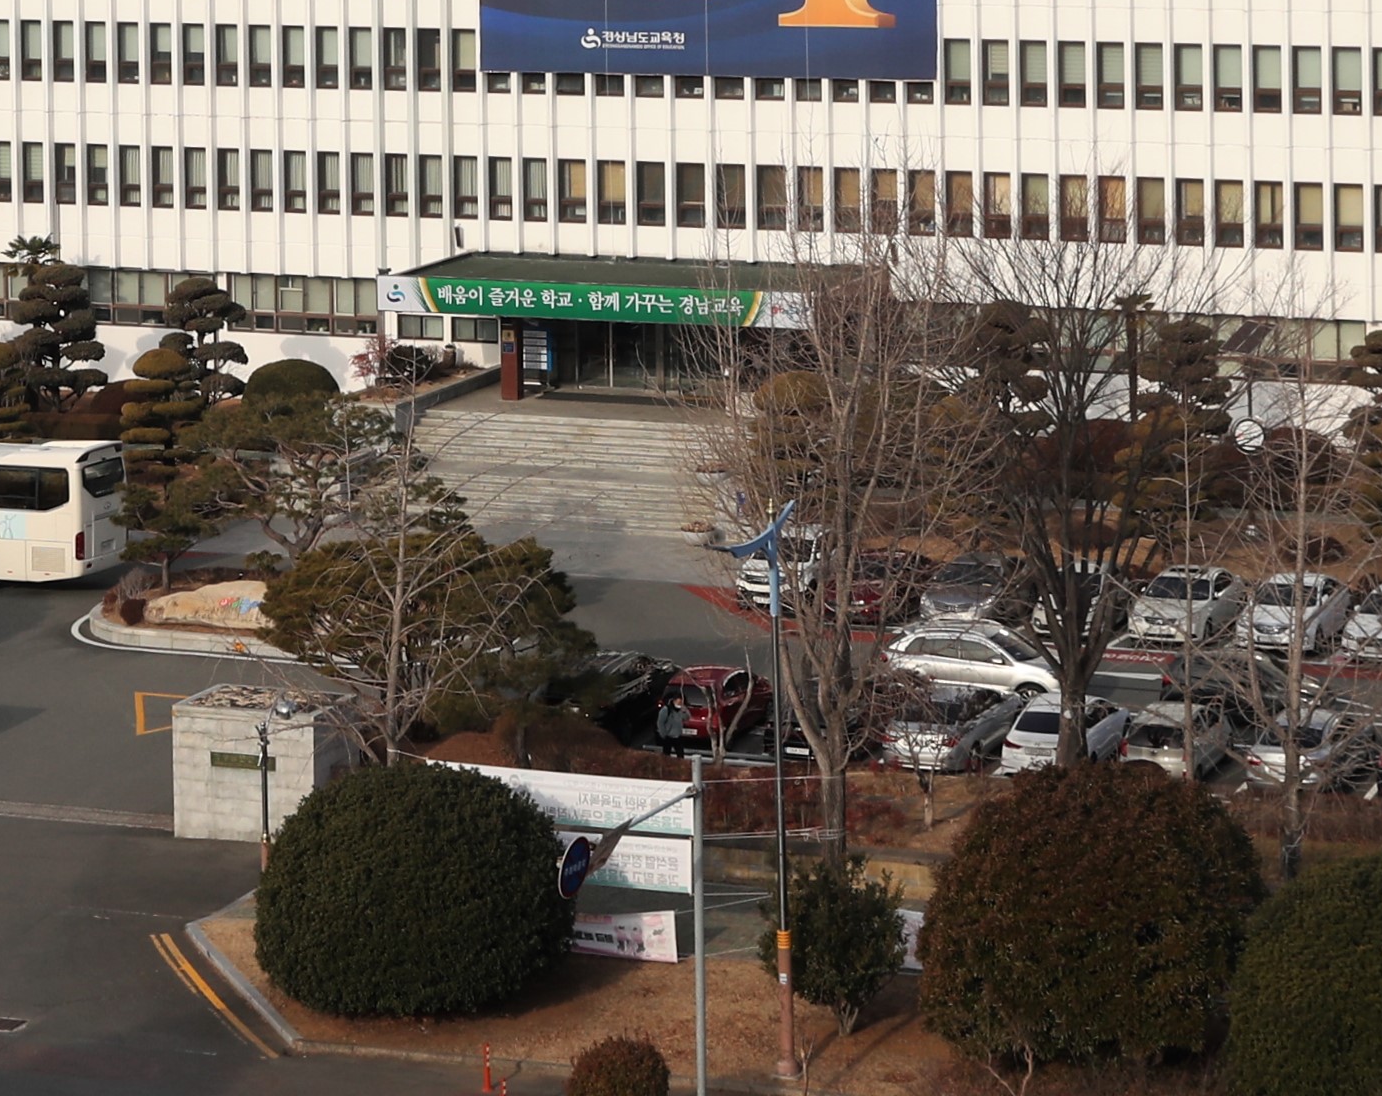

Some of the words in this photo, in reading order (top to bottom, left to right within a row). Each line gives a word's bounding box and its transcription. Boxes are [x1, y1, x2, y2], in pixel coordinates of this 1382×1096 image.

[602, 31, 684, 44] 경상남도교육청
[436, 286, 483, 307] 배움이
[487, 288, 536, 309] 즐거운
[540, 289, 574, 310] 학교
[588, 291, 620, 312] 함께
[624, 292, 675, 314] 가꾸는
[678, 295, 745, 317] 경남교육
